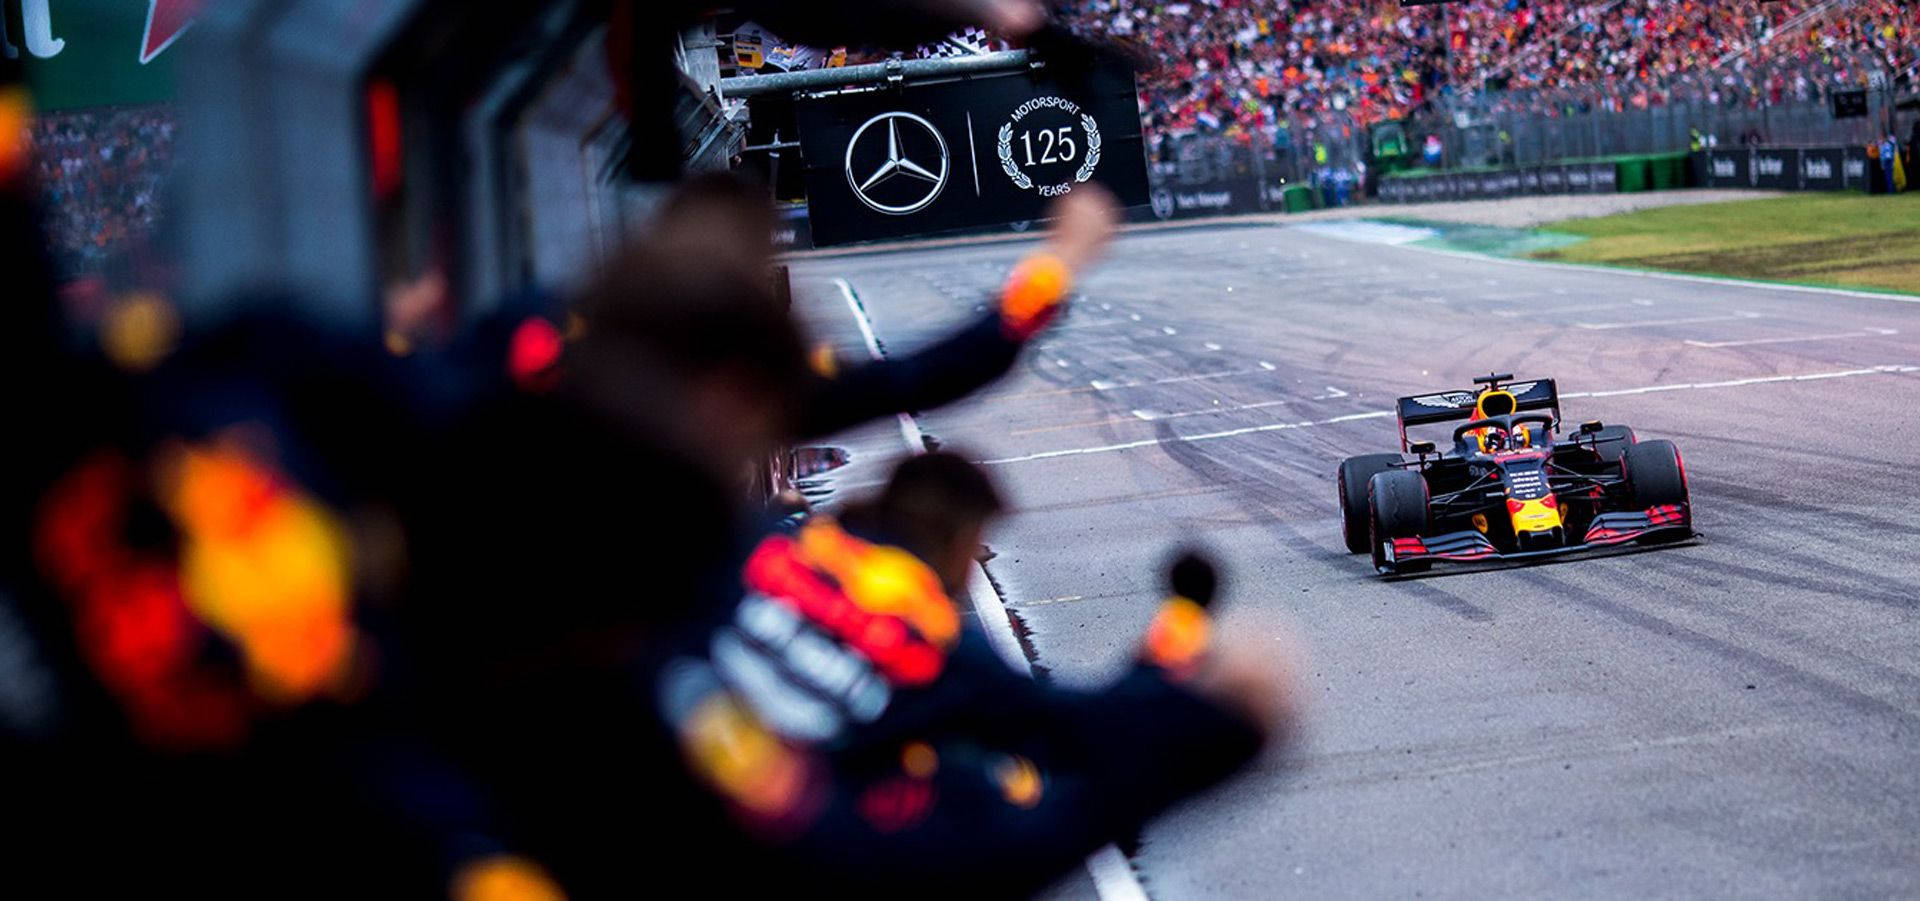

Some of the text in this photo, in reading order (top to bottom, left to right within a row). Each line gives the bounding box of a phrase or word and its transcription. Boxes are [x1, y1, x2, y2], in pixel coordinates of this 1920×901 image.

[1011, 96, 1080, 122] MOTORSPORT
[1020, 127, 1076, 166] 125
[1038, 182, 1072, 196] YEARS
